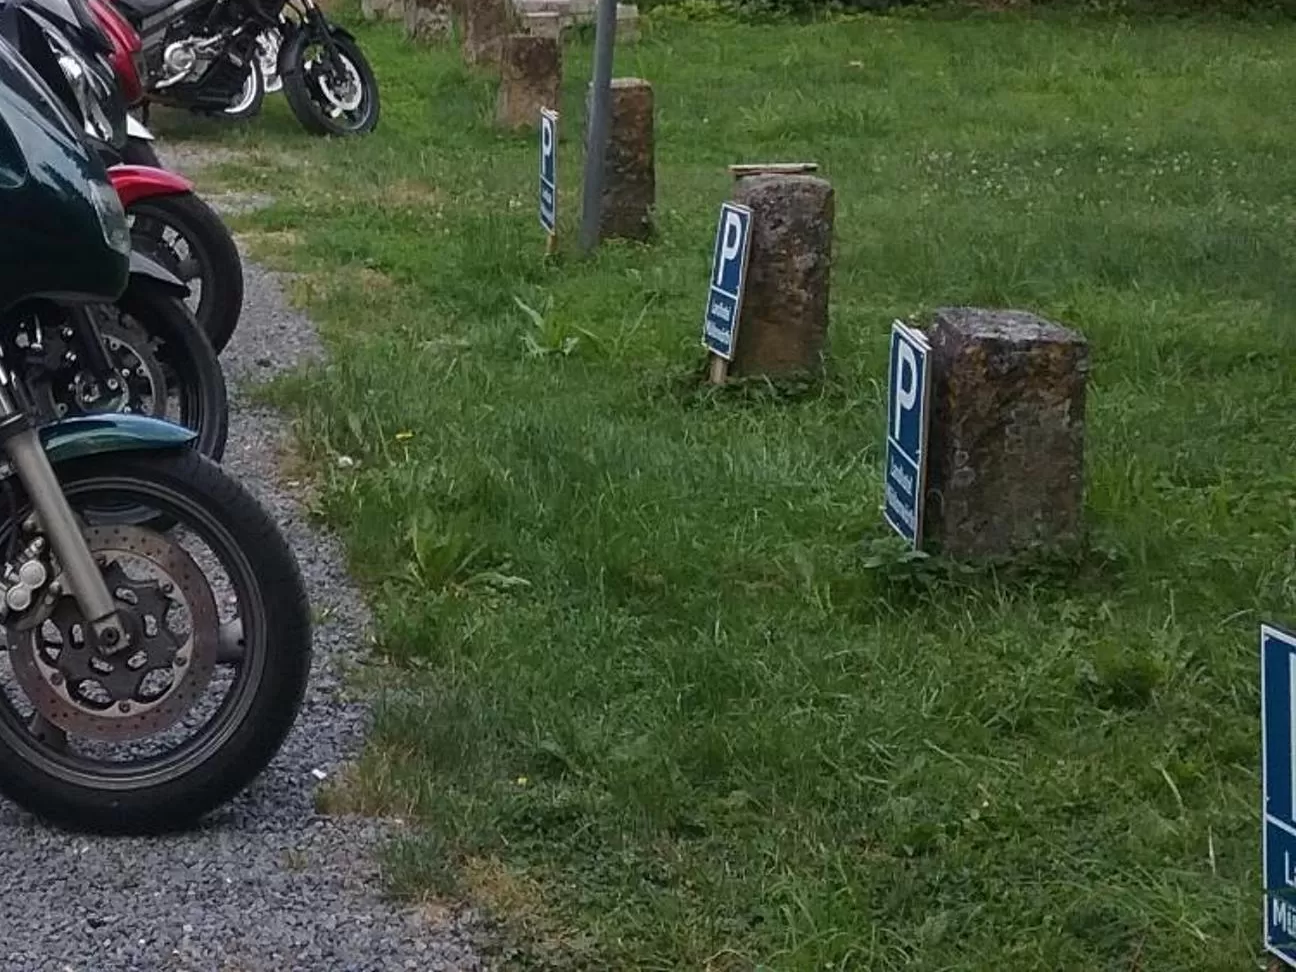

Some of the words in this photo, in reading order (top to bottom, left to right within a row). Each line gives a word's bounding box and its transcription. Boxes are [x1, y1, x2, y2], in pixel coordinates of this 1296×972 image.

[542, 117, 552, 175] P
[717, 211, 742, 286] P
[895, 338, 918, 440] P
